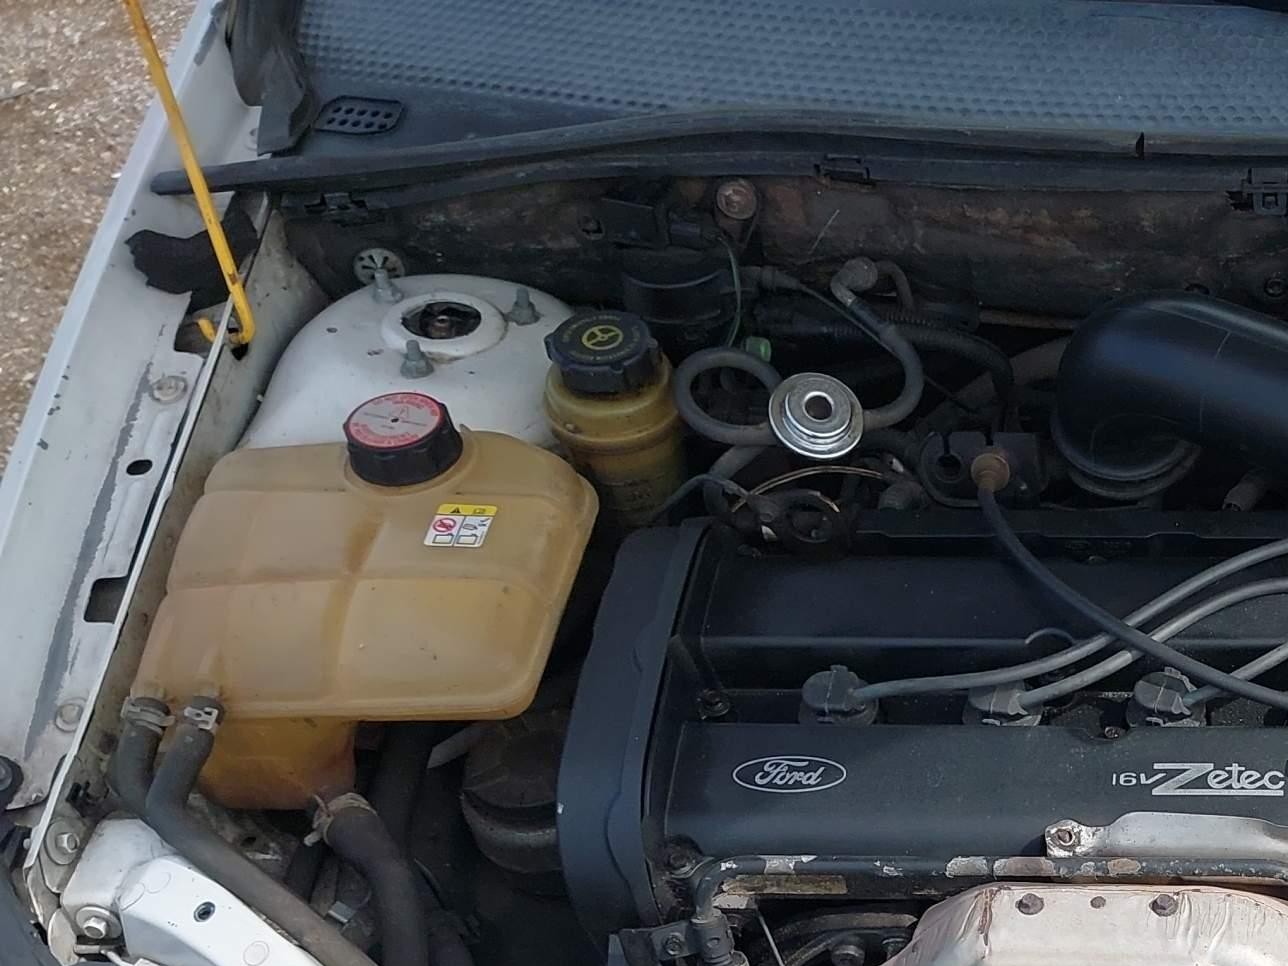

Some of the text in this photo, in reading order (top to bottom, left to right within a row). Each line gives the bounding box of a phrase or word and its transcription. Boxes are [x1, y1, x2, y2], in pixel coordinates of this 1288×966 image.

[755, 760, 825, 785] Ford
[1112, 762, 1286, 797] 16V Zetec
